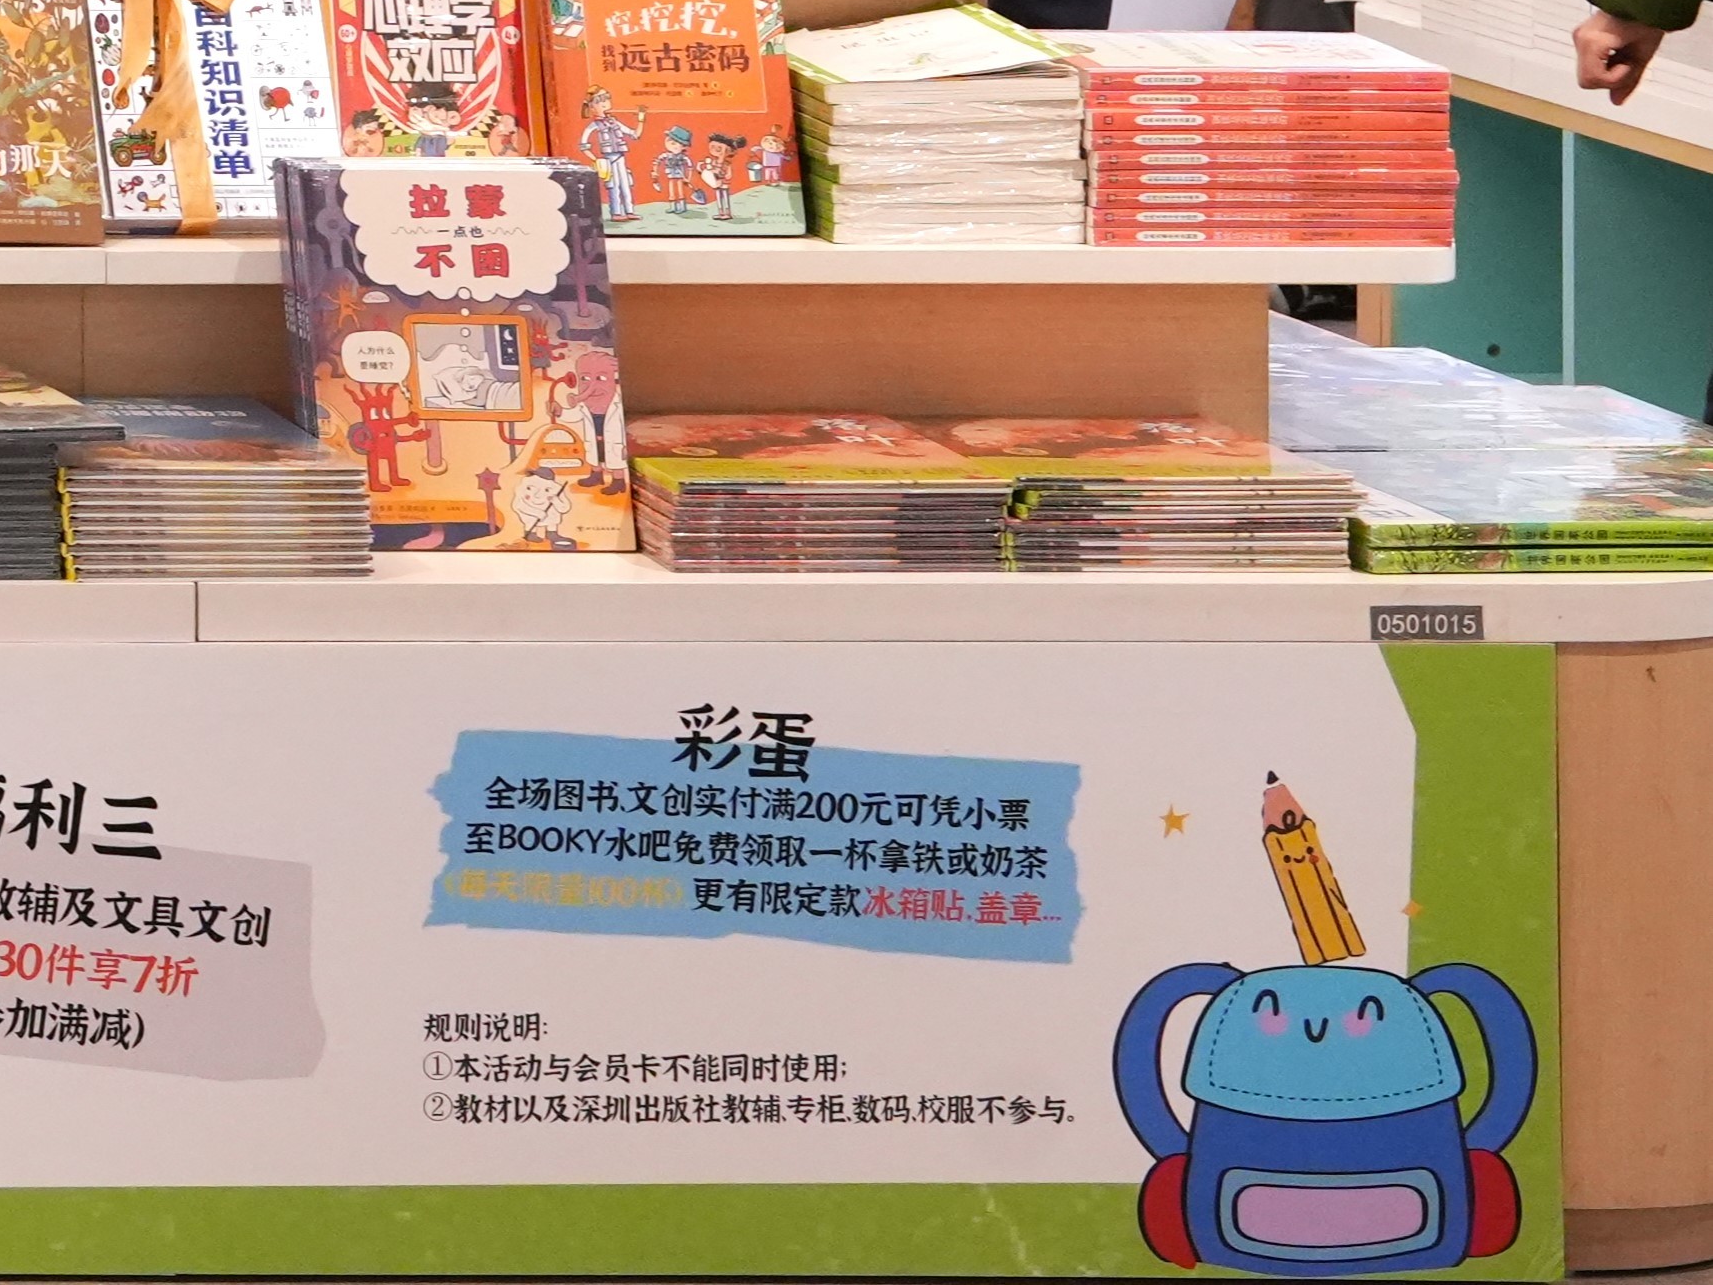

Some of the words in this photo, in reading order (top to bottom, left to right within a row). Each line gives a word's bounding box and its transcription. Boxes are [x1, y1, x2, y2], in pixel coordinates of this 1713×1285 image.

[387, 38, 479, 83] 效应
[618, 42, 750, 74] 远古密码
[408, 183, 509, 221] 拉蒙
[1376, 612, 1478, 636] 0501015
[672, 703, 817, 782] 彩蛋
